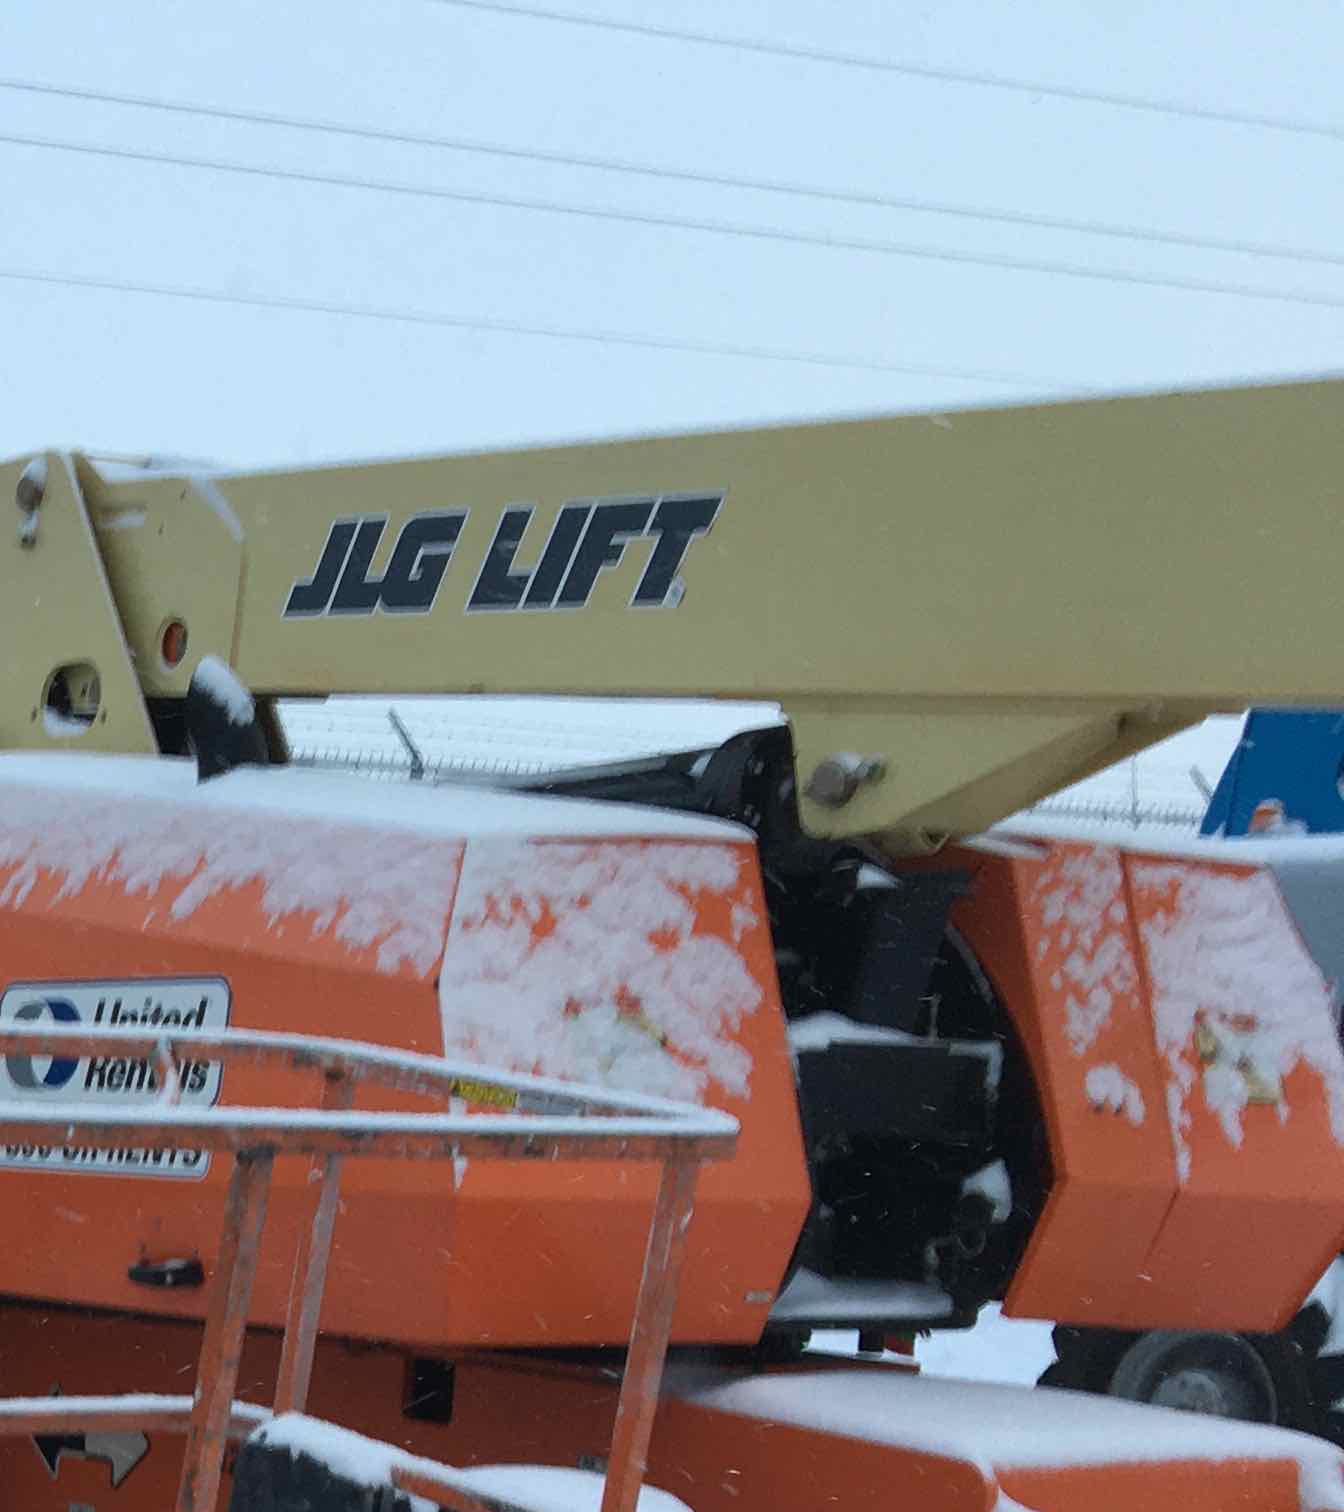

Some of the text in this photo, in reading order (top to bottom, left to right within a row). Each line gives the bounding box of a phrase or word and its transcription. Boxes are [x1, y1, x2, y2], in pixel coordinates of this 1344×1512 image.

[281, 487, 728, 619] JLG LIFT
[83, 1057, 210, 1094] Rentls
